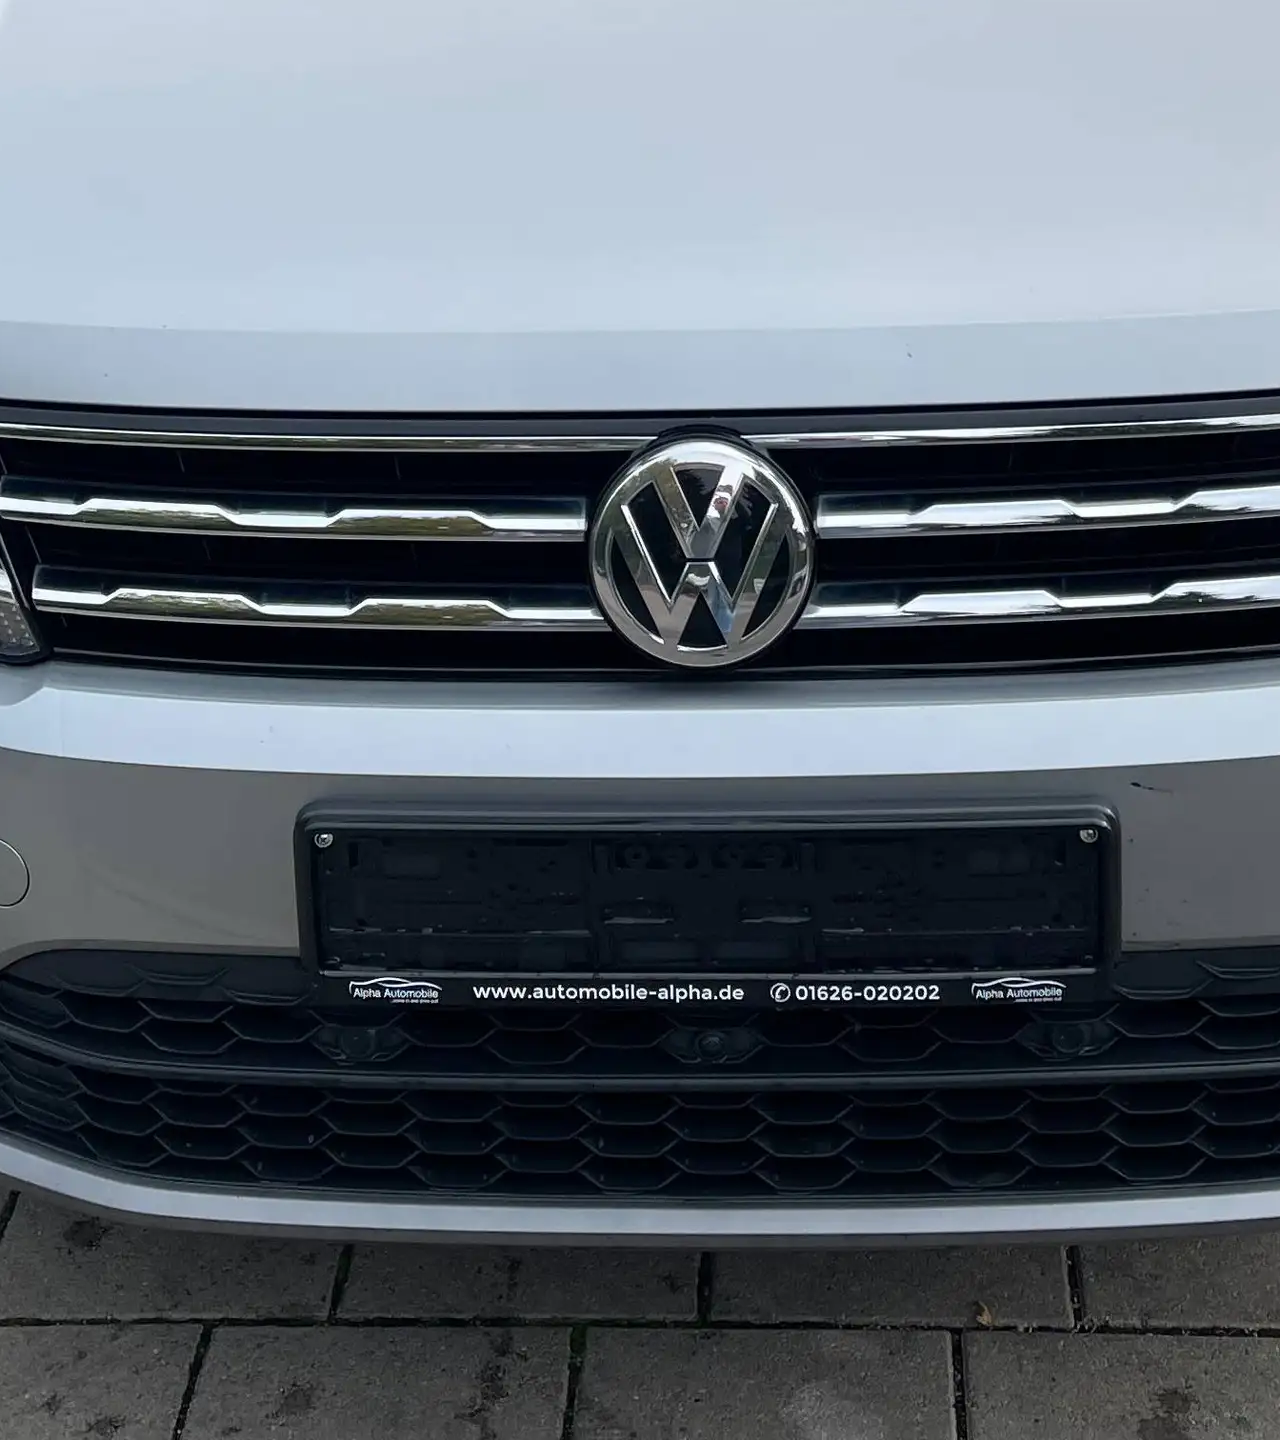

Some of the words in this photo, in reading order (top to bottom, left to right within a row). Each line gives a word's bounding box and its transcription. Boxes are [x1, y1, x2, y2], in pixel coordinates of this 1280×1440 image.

[353, 987, 382, 1000] Alpha
[383, 986, 439, 999] Automobile
[472, 983, 745, 1003] www.automobile-alpha.de
[795, 984, 941, 1002] 01626-020202
[976, 988, 1005, 1001] Alpha
[1006, 986, 1063, 999] Automobile
